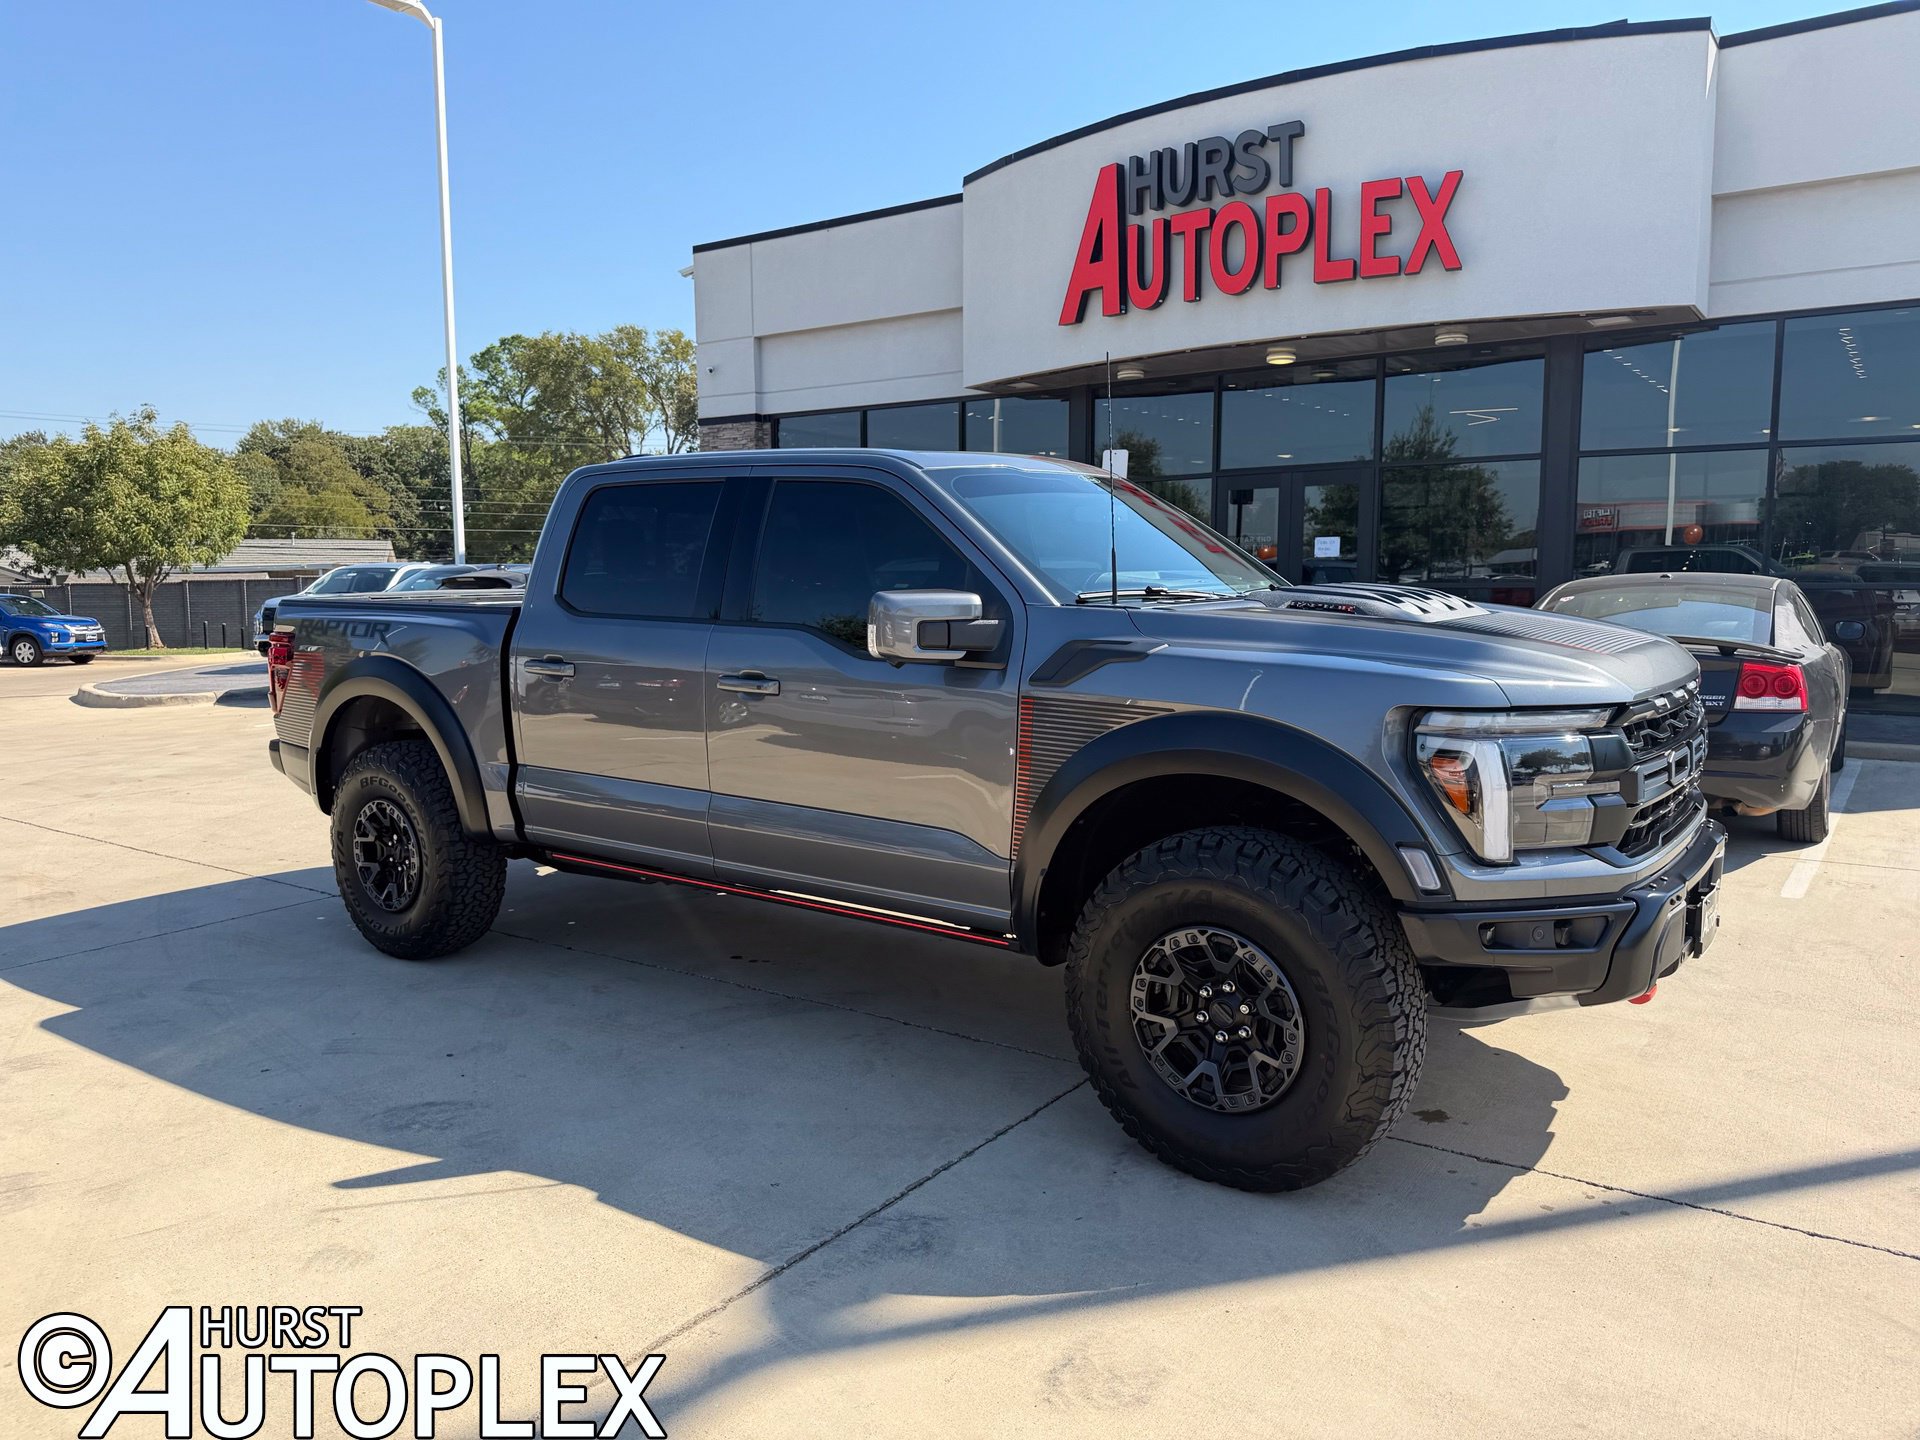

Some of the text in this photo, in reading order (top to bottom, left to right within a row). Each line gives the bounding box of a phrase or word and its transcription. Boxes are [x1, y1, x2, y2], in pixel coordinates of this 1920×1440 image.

[1128, 120, 1305, 216] HURST
[1058, 163, 1464, 326] AUTOPLEX
[299, 618, 392, 650] RAPTOR
[1637, 732, 1708, 802] FOR
